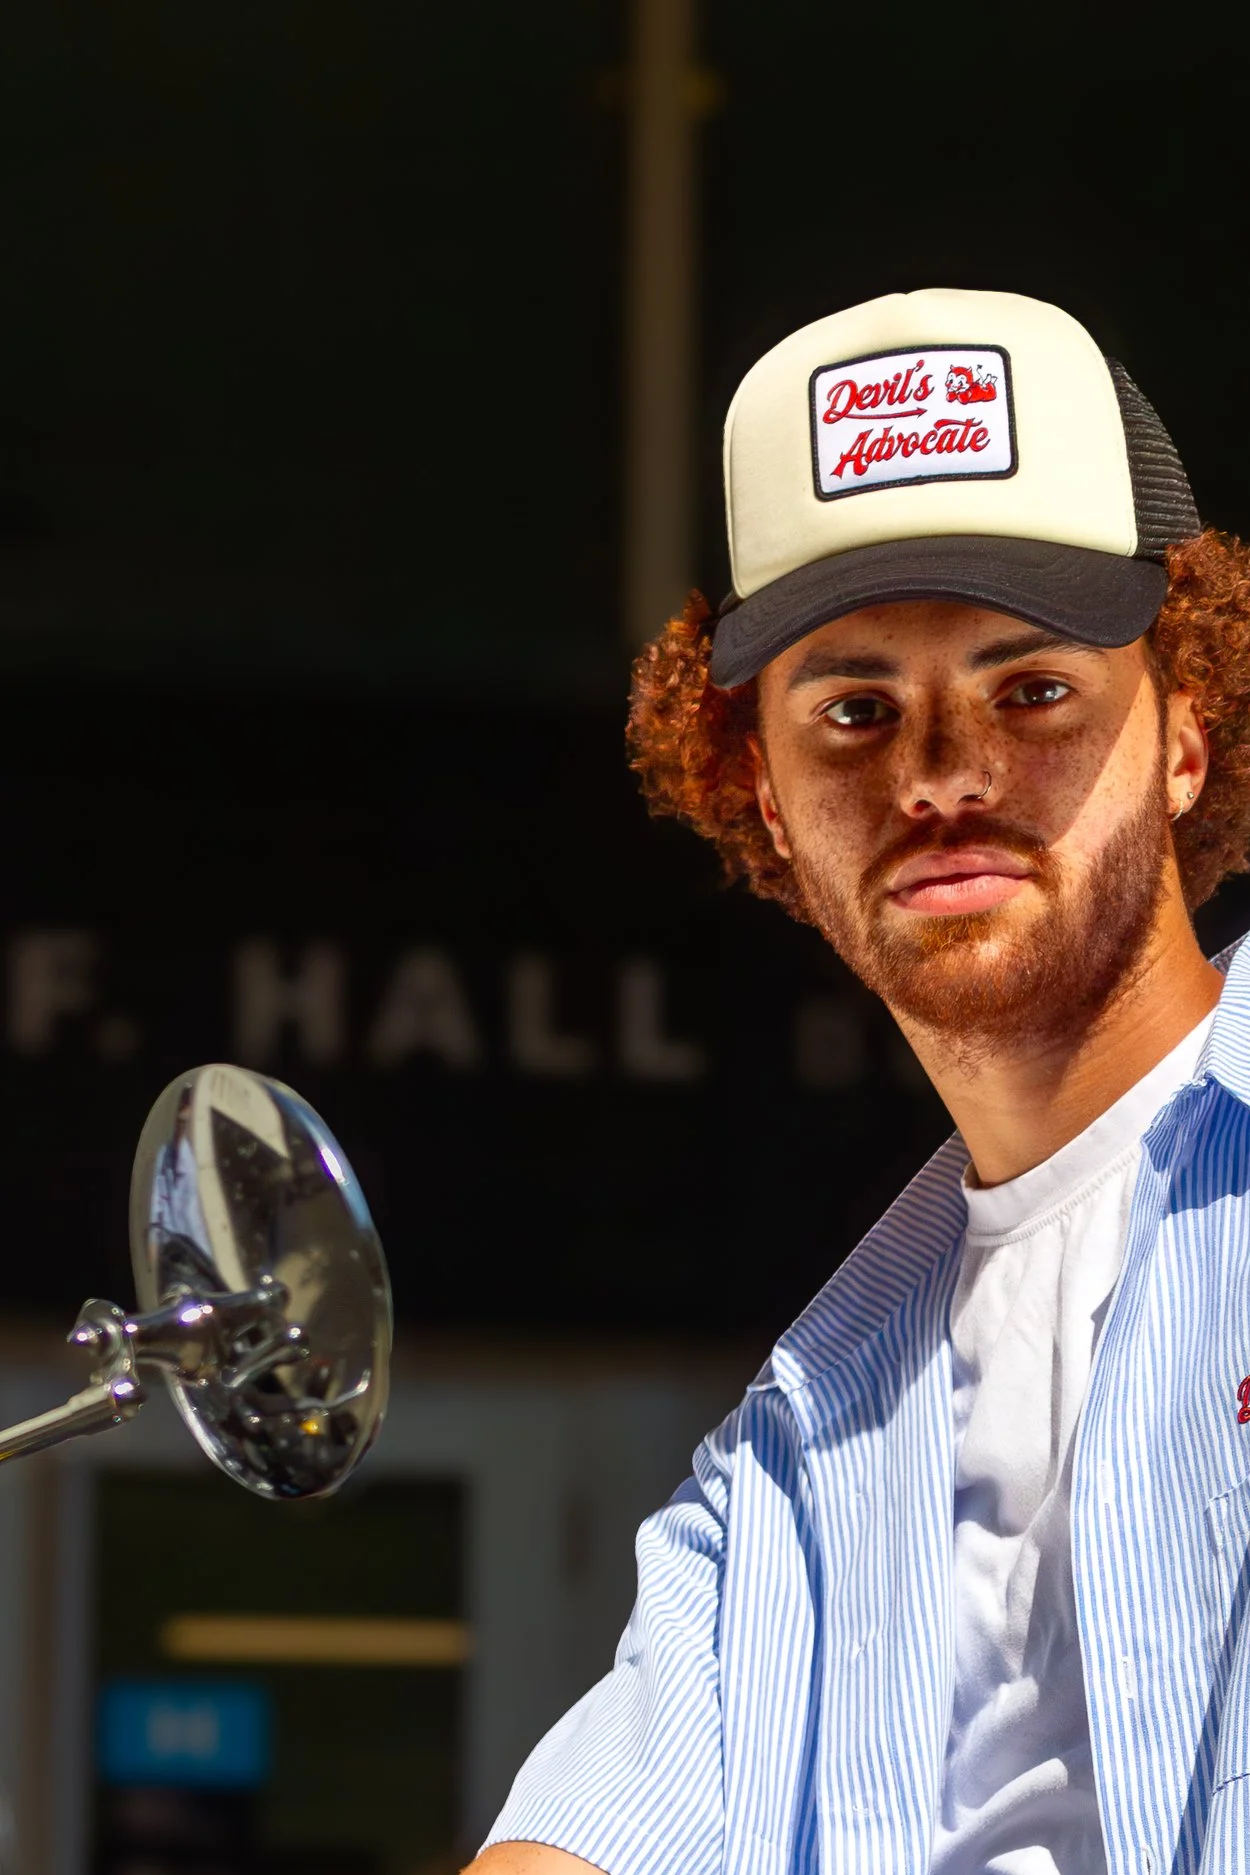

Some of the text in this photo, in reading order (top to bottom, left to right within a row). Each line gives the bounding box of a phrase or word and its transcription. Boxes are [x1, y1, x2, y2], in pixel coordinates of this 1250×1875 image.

[822, 358, 936, 425] Devil's
[830, 417, 990, 479] Advocate
[233, 937, 706, 1081] HALL
